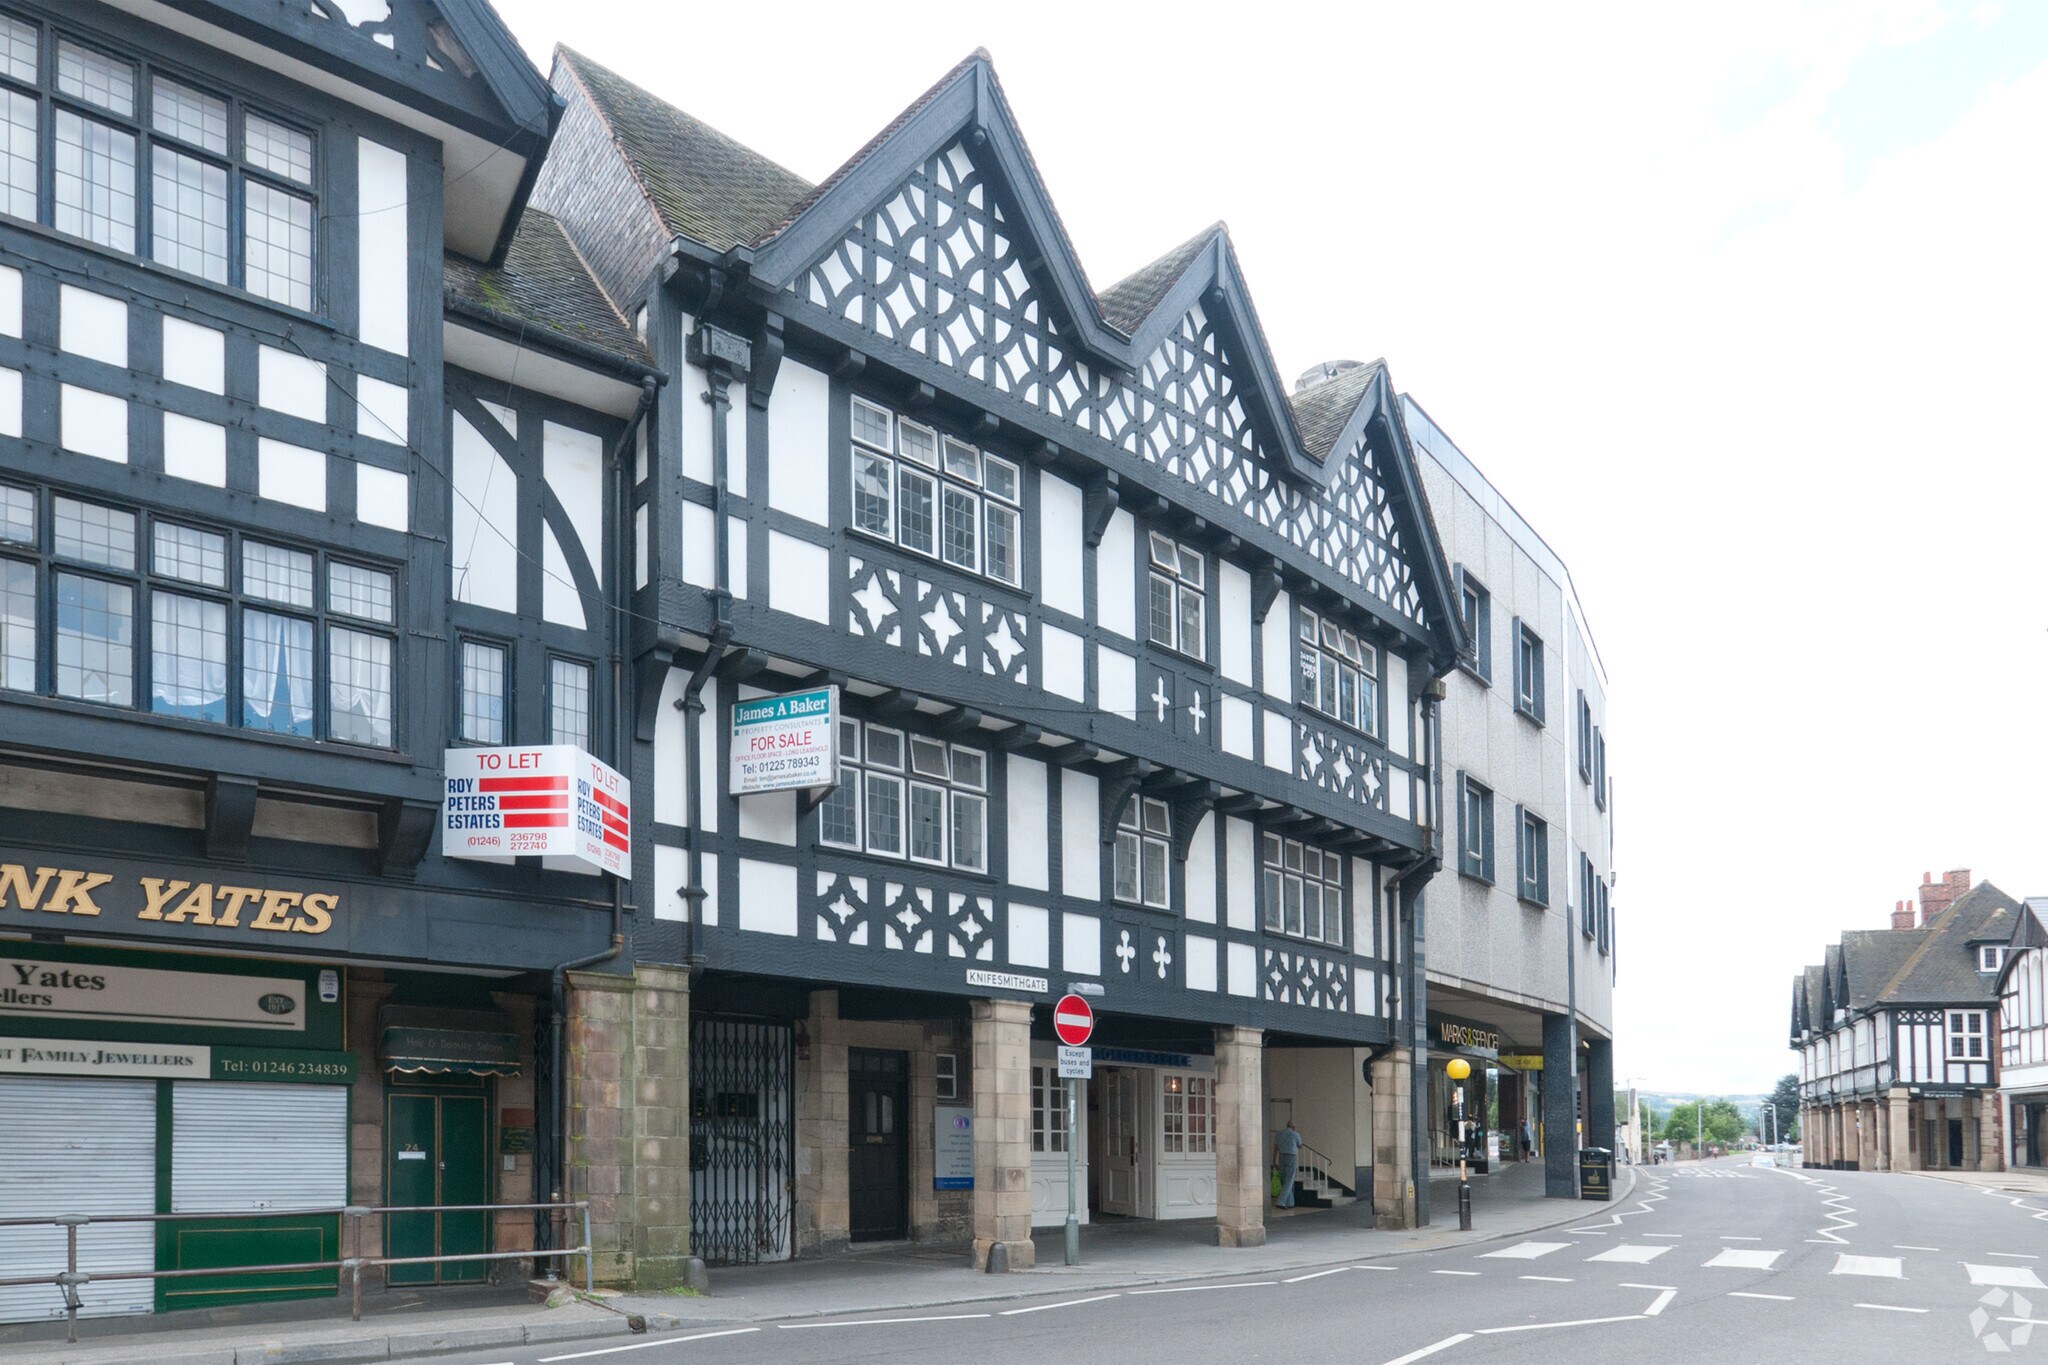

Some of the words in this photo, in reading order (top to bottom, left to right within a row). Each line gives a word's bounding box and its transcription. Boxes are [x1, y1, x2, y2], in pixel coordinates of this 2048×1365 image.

[736, 706, 774, 722] James
[777, 702, 787, 716] A
[790, 697, 827, 715] Baker
[741, 725, 772, 735] PROPERTY
[774, 718, 822, 732] CONSULTANTS
[751, 735, 776, 752] FOR
[779, 731, 812, 748] SALE
[477, 754, 501, 770] TO
[508, 753, 542, 769] LET
[742, 763, 757, 774] Tel:
[759, 761, 785, 773] 01225
[787, 755, 819, 769] 789343
[448, 778, 473, 793] ROY
[591, 763, 602, 783] TO
[605, 774, 619, 794] LET
[578, 778, 591, 797] ROY
[448, 795, 495, 811] PETERS
[578, 797, 601, 821] PETERS
[448, 814, 500, 829] ESTATES
[578, 815, 602, 840] ESTATES
[467, 836, 501, 848] (01246)
[510, 832, 547, 841] 236798
[510, 841, 547, 850] 272740
[0, 864, 113, 916] NK
[137, 876, 340, 935] YATES
[10, 963, 105, 991] Yates
[969, 972, 1047, 990] KNIFESMITHGATE
[21, 1047, 91, 1063] FAMILY
[92, 1050, 194, 1066] JEWELLERS
[1065, 1049, 1085, 1057] Except
[221, 1059, 249, 1072] Tel:
[252, 1061, 295, 1074] 01246
[297, 1063, 348, 1076] 234839
[1066, 1067, 1084, 1076] cycles
